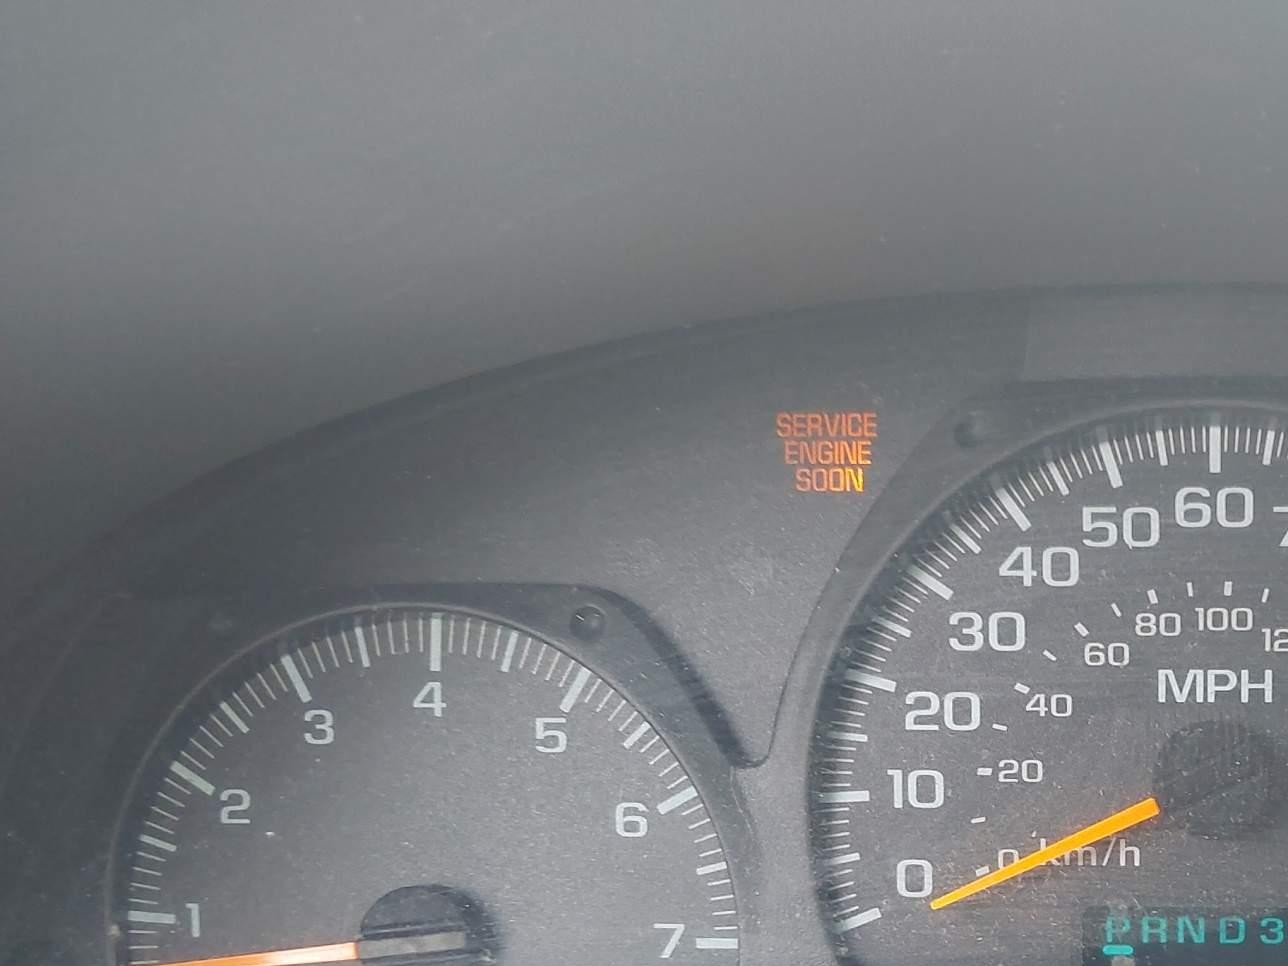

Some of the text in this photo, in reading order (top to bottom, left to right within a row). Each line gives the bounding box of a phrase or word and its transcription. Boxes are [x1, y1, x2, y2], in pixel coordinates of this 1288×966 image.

[776, 412, 878, 438] SERVICE
[784, 440, 872, 464] ENGINE
[795, 467, 864, 492] SOON
[1175, 486, 1254, 528] 60
[1082, 506, 1160, 548] 50
[999, 547, 1079, 587] 40
[949, 612, 1026, 651] 30
[1135, 613, 1182, 637] 80
[1195, 607, 1253, 631] 100
[1084, 643, 1130, 666] 60
[413, 683, 447, 717] 4
[1157, 669, 1273, 703] MPH
[905, 692, 980, 731] 20
[1026, 694, 1072, 717] 40
[304, 710, 335, 745] 3
[535, 718, 567, 753] 5
[887, 768, 944, 809] 10
[999, 760, 1043, 783] 20
[220, 790, 251, 824] 2
[615, 803, 648, 838] 6
[897, 859, 934, 897] 0
[187, 903, 200, 938] 1
[653, 924, 685, 959] 7
